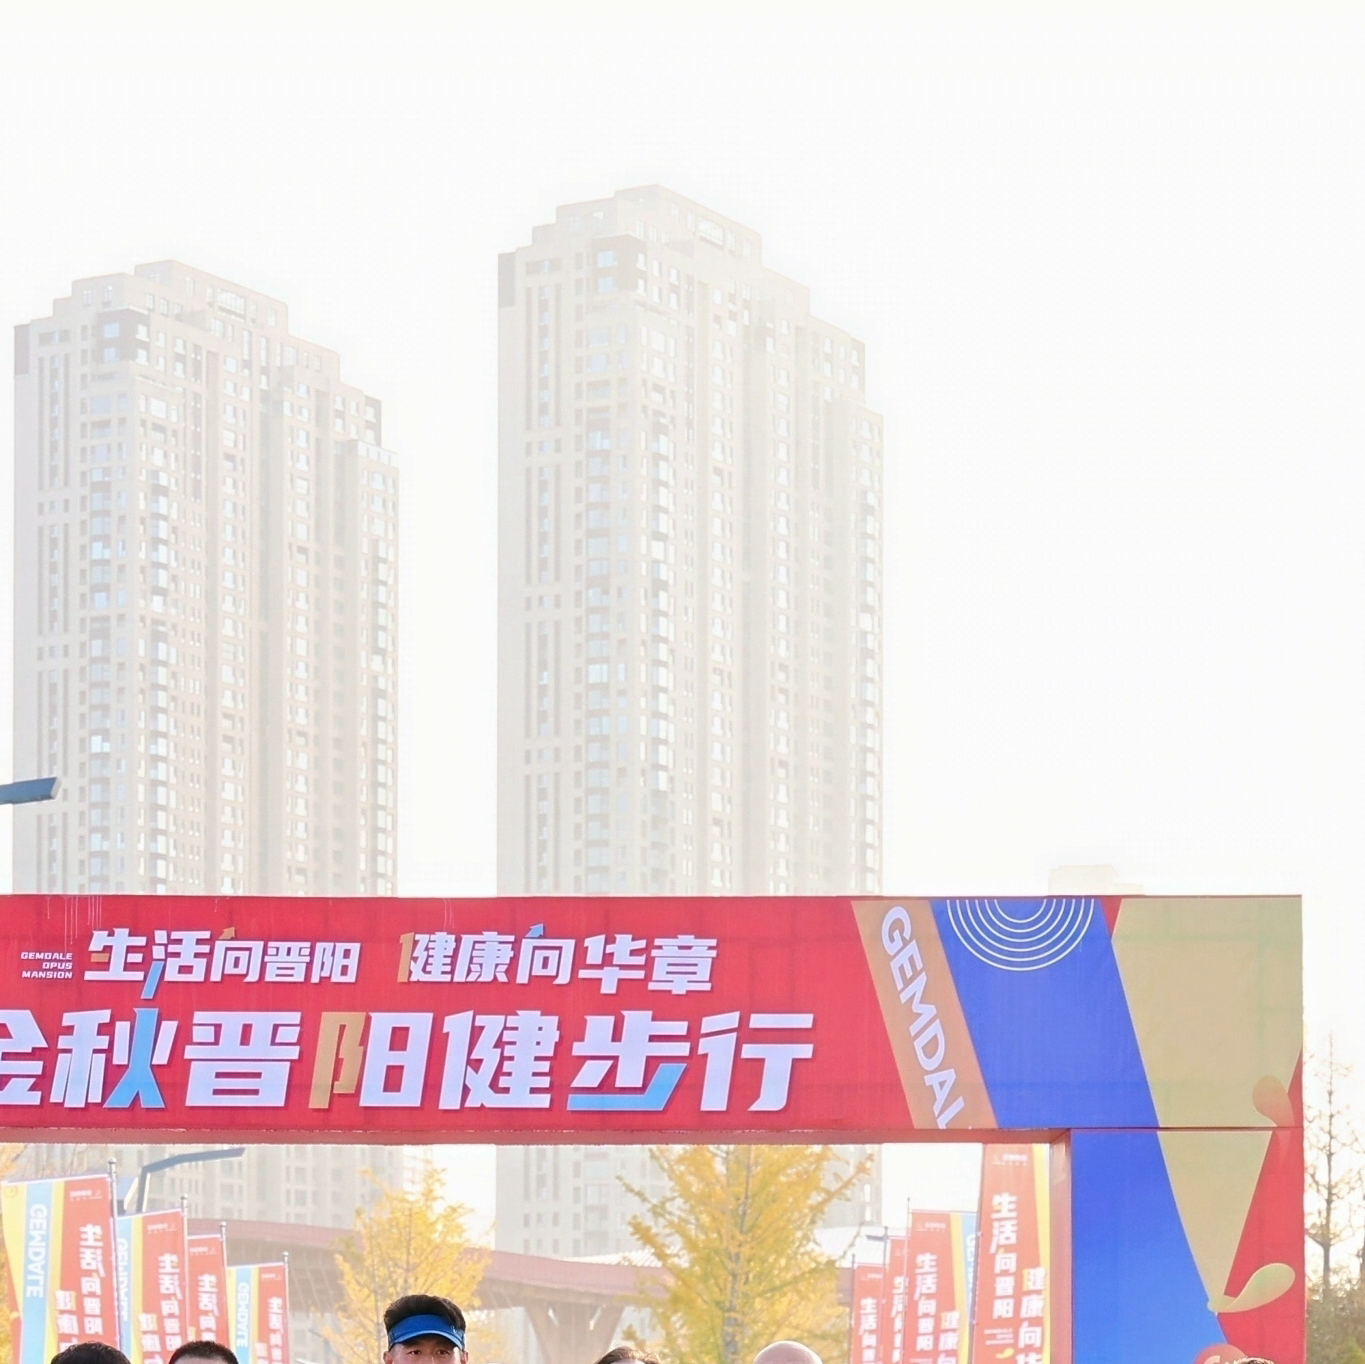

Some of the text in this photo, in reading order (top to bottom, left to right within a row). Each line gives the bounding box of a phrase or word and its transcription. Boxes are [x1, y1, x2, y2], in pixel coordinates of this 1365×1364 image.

[20, 952, 73, 961] GEMDALE
[21, 970, 73, 979] MANSION
[42, 961, 73, 970] OPUS
[83, 924, 717, 1000] 生活向晋阳 健康向华章
[989, 1192, 1018, 1319] 生活向晋阳
[914, 1252, 938, 1352] 生活向晋阳
